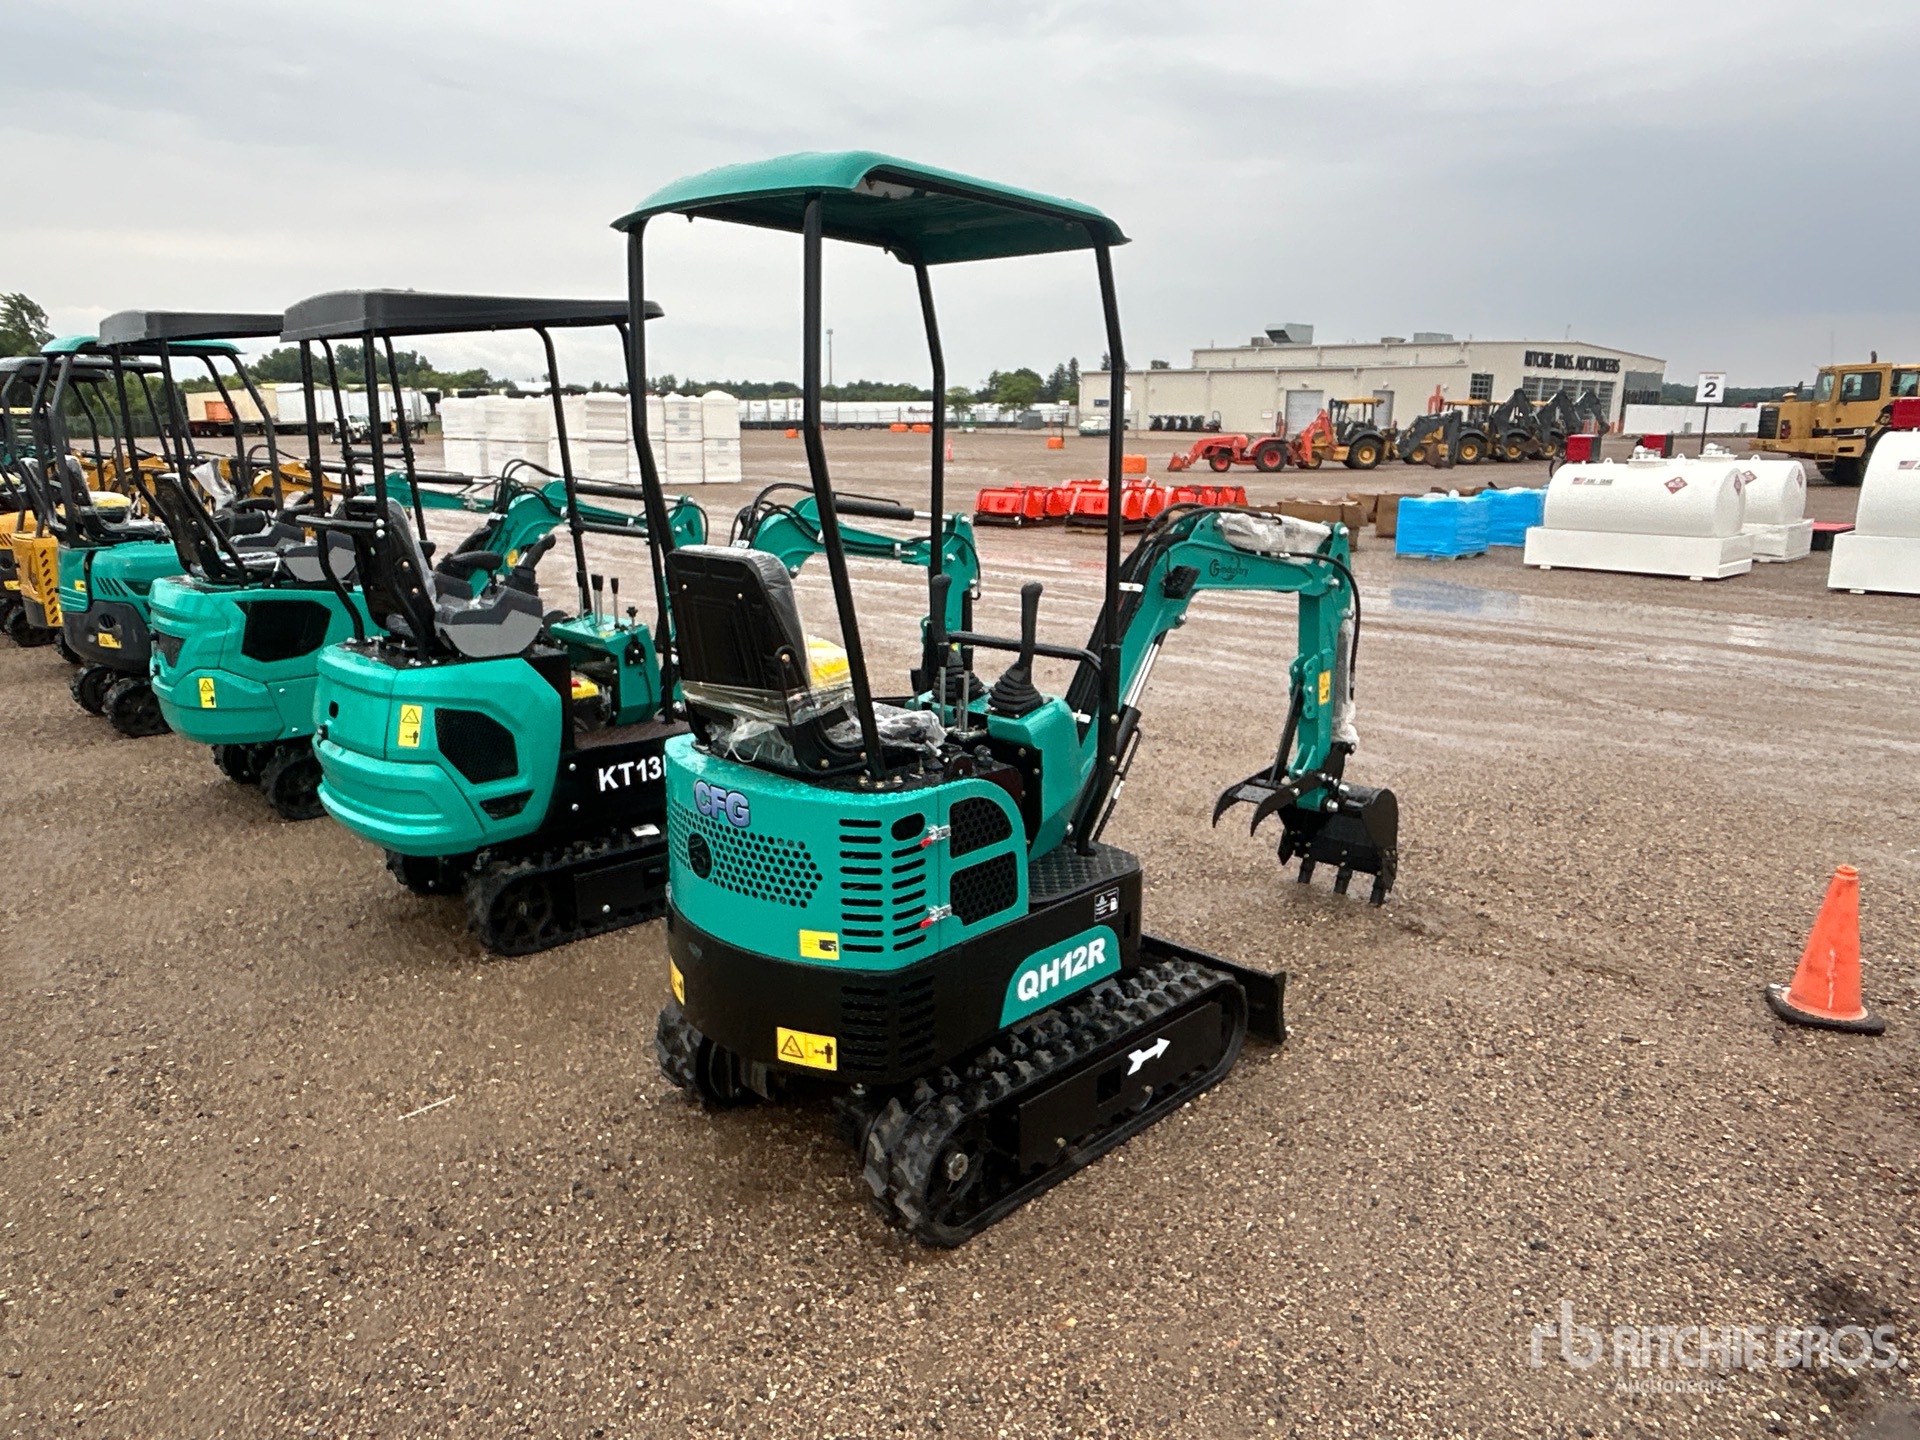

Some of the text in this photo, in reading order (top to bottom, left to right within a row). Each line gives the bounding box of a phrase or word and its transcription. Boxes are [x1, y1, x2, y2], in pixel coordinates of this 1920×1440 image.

[1704, 382, 1717, 398] 2
[694, 779, 751, 829] CFG
[1017, 937, 1107, 1002] QH12R
